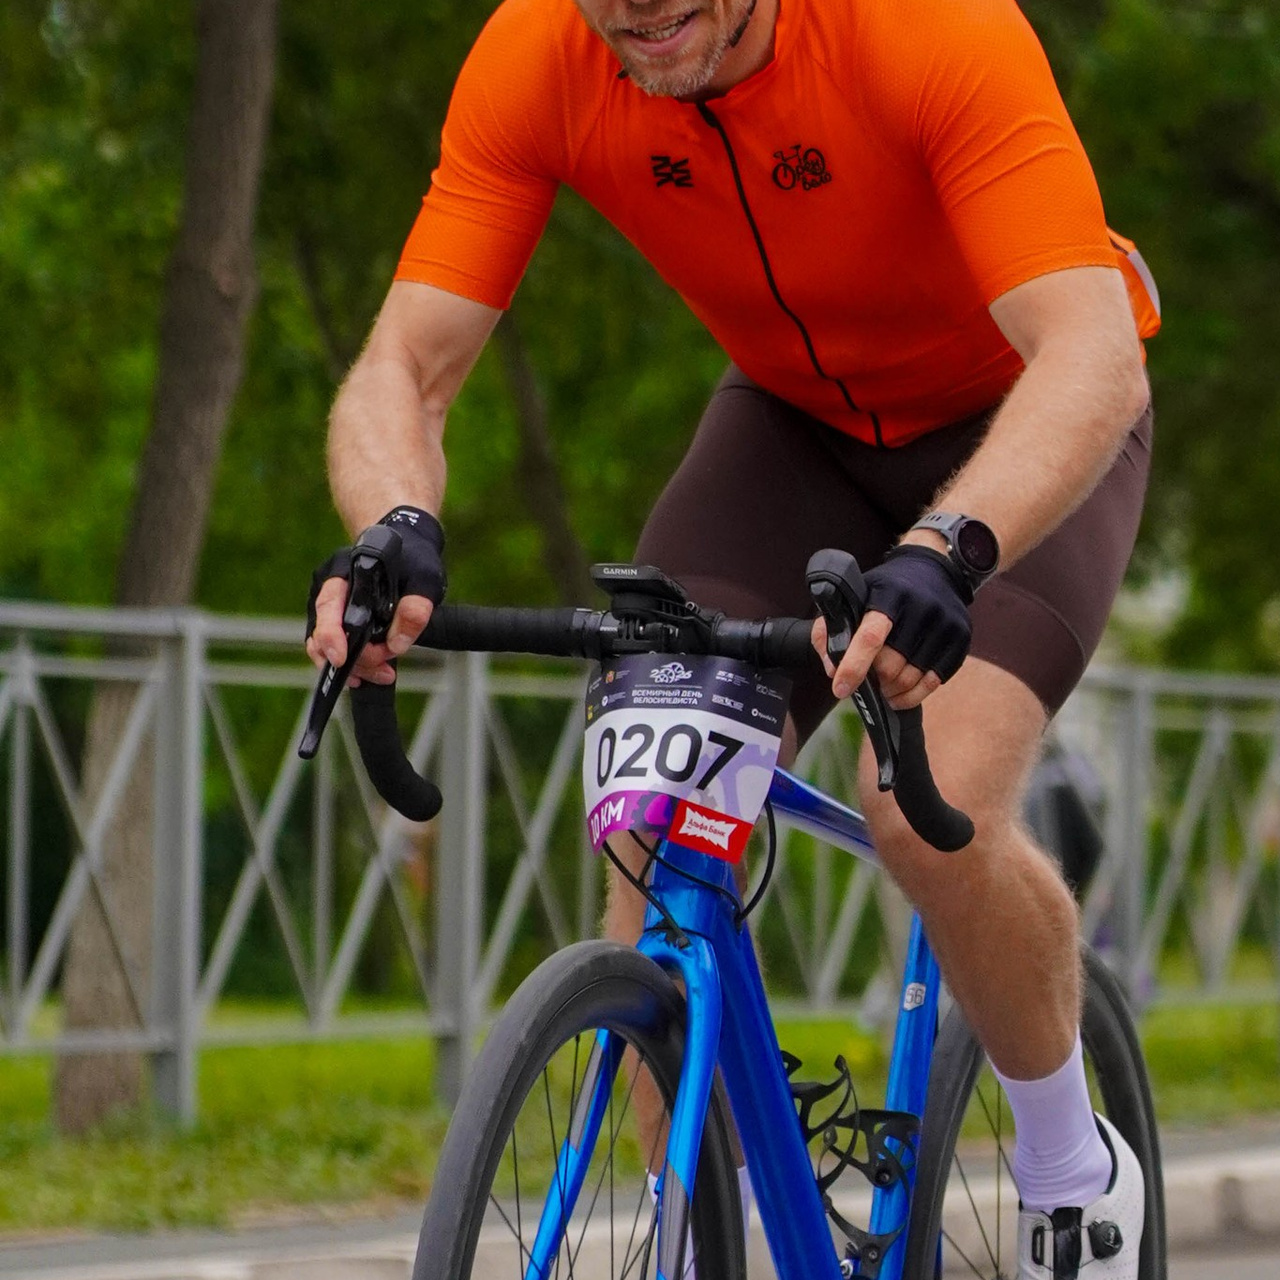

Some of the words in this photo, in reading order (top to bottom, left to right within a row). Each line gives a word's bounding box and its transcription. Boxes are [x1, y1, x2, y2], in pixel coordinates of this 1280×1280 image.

[603, 567, 638, 576] GARMIN
[631, 689, 680, 697] ВСЕМИРНЫЙ
[681, 690, 703, 698] ДЕНЬ
[633, 696, 698, 705] ВЕЛОСИПЕДИСТА
[596, 723, 745, 791] 0207
[590, 813, 600, 845] 10
[688, 819, 708, 832] Альфа
[708, 825, 726, 837] Банк
[905, 987, 924, 1005] 56
